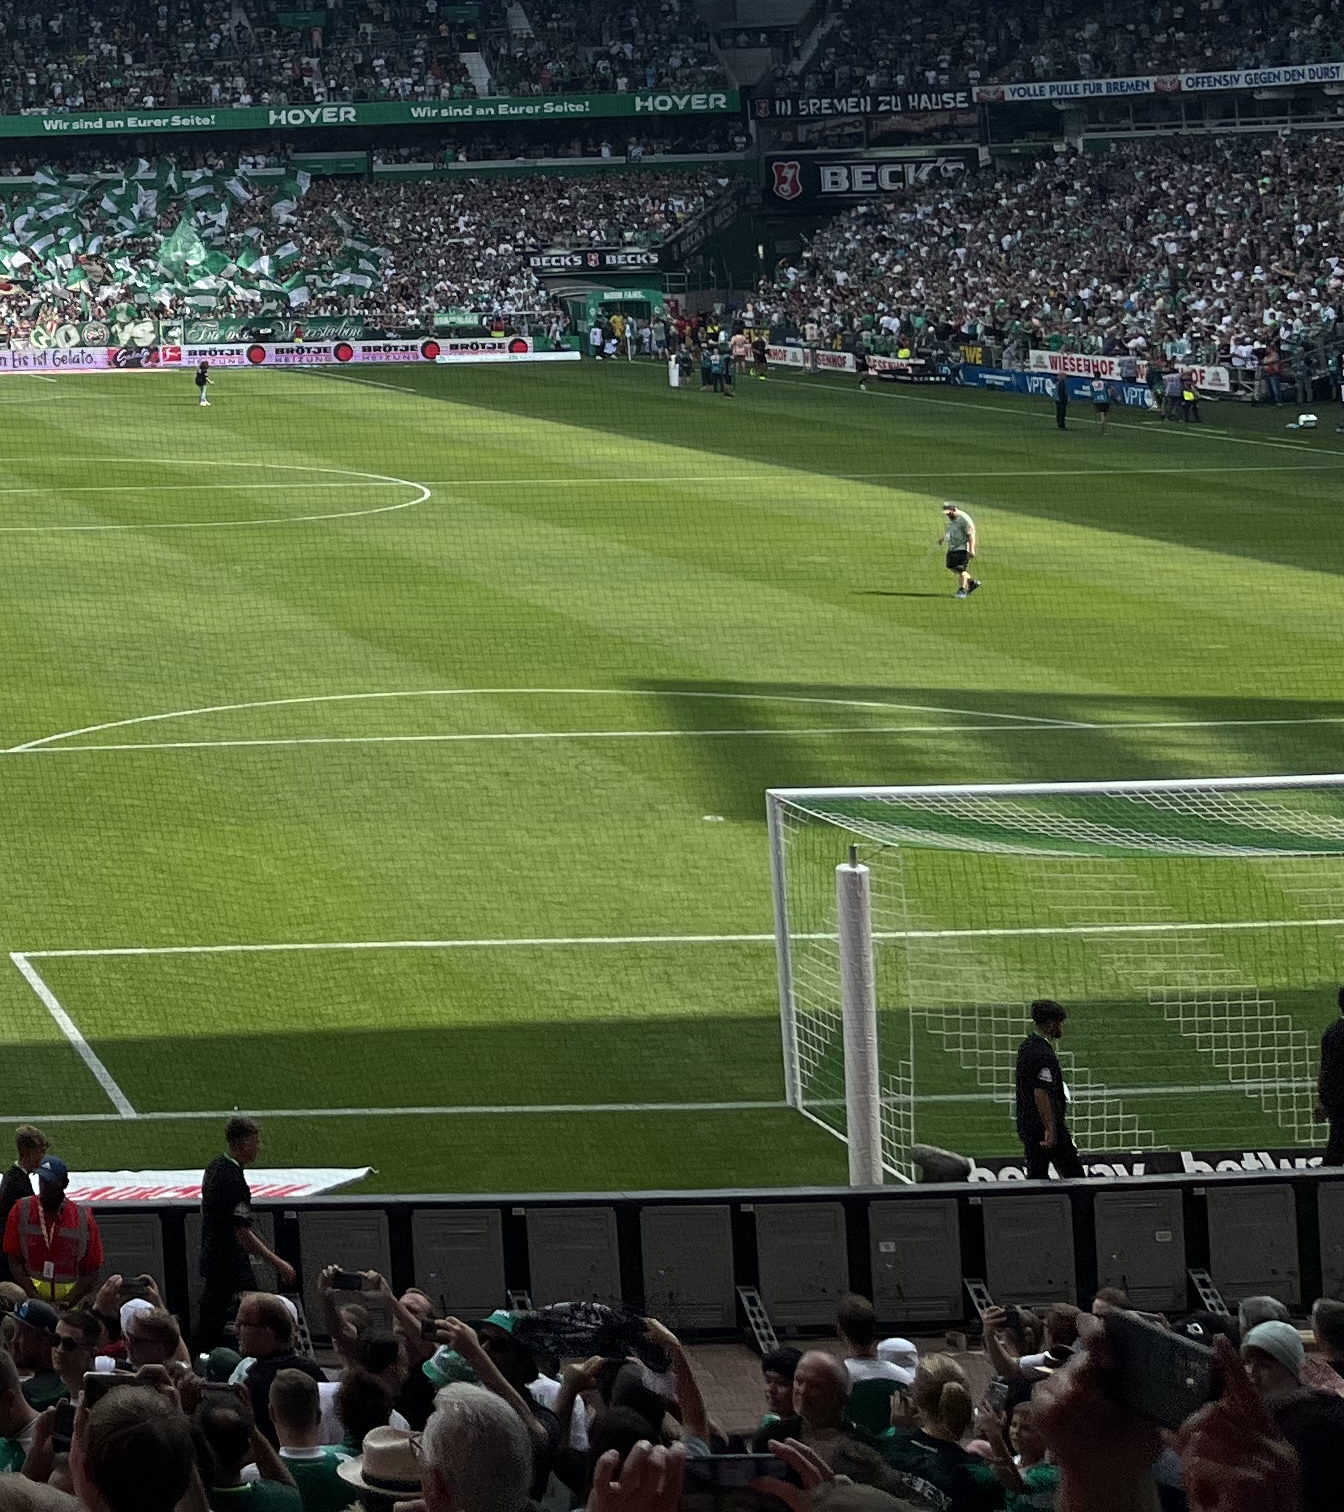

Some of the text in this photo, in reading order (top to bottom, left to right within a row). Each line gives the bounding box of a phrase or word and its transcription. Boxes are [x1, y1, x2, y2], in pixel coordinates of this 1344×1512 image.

[1186, 66, 1340, 88] OFFENSIV GEGEN DEN DURST
[1009, 86, 1045, 98] VOLLE
[1049, 84, 1079, 96] PULLE
[1106, 80, 1150, 93] BREMEN
[411, 101, 589, 118] Wir sind an Eurer Seite!
[635, 94, 726, 112] HOYER
[775, 100, 792, 116] IN
[878, 95, 902, 112] ZU
[909, 92, 969, 111] HAUSE
[43, 115, 215, 131] Wir sind an Eurer Seite!
[270, 108, 356, 126] HOYER
[530, 254, 582, 267] BECK'S
[606, 252, 659, 264] BECK'S
[188, 347, 244, 356] BRÖTJE
[275, 345, 332, 355] BRÖTJE
[362, 342, 418, 352] BRÖTJE
[449, 341, 506, 350] BRÖTJE
[12, 350, 28, 368] Eis
[33, 349, 47, 366] ist
[53, 349, 97, 367] Gelato.
[1049, 353, 1114, 376] WIESENHOF
[1026, 376, 1044, 393] VPT
[1123, 388, 1143, 405] VPT
